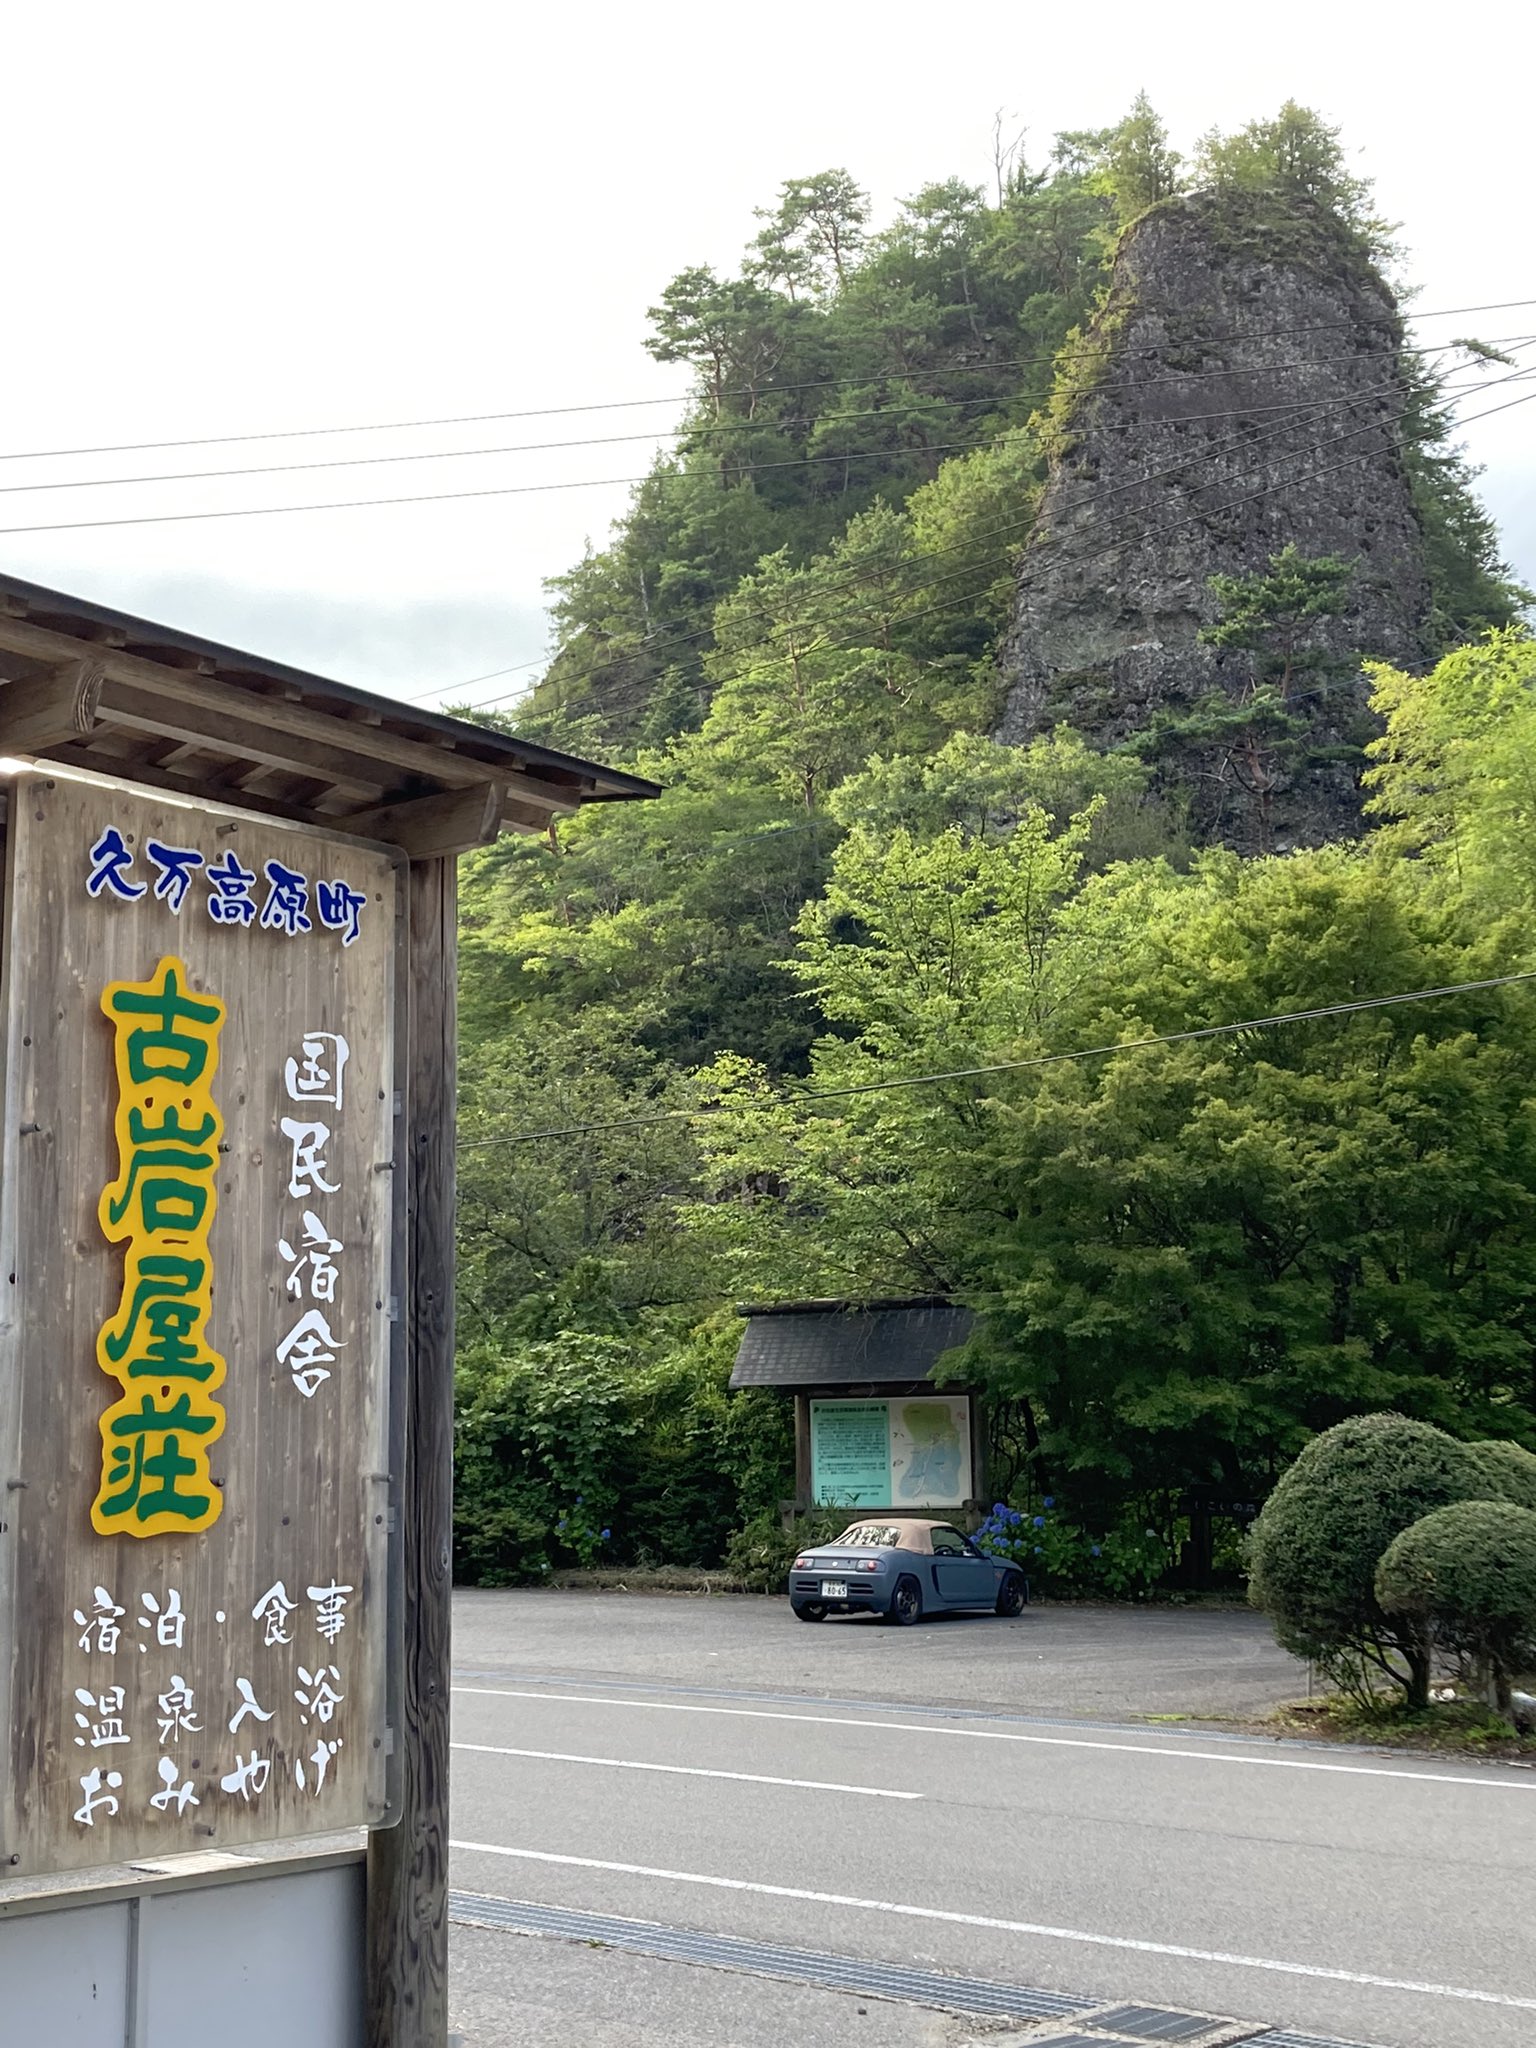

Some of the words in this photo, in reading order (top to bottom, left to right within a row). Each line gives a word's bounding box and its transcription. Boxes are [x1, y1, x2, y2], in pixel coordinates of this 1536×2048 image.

[87, 825, 367, 947] 久万高原町
[100, 968, 221, 1522] 古岩屋荘
[276, 1031, 349, 1398] 国民宿舎
[74, 1665, 345, 1748] 温泉入浴
[73, 1738, 344, 1826] おみやげ
